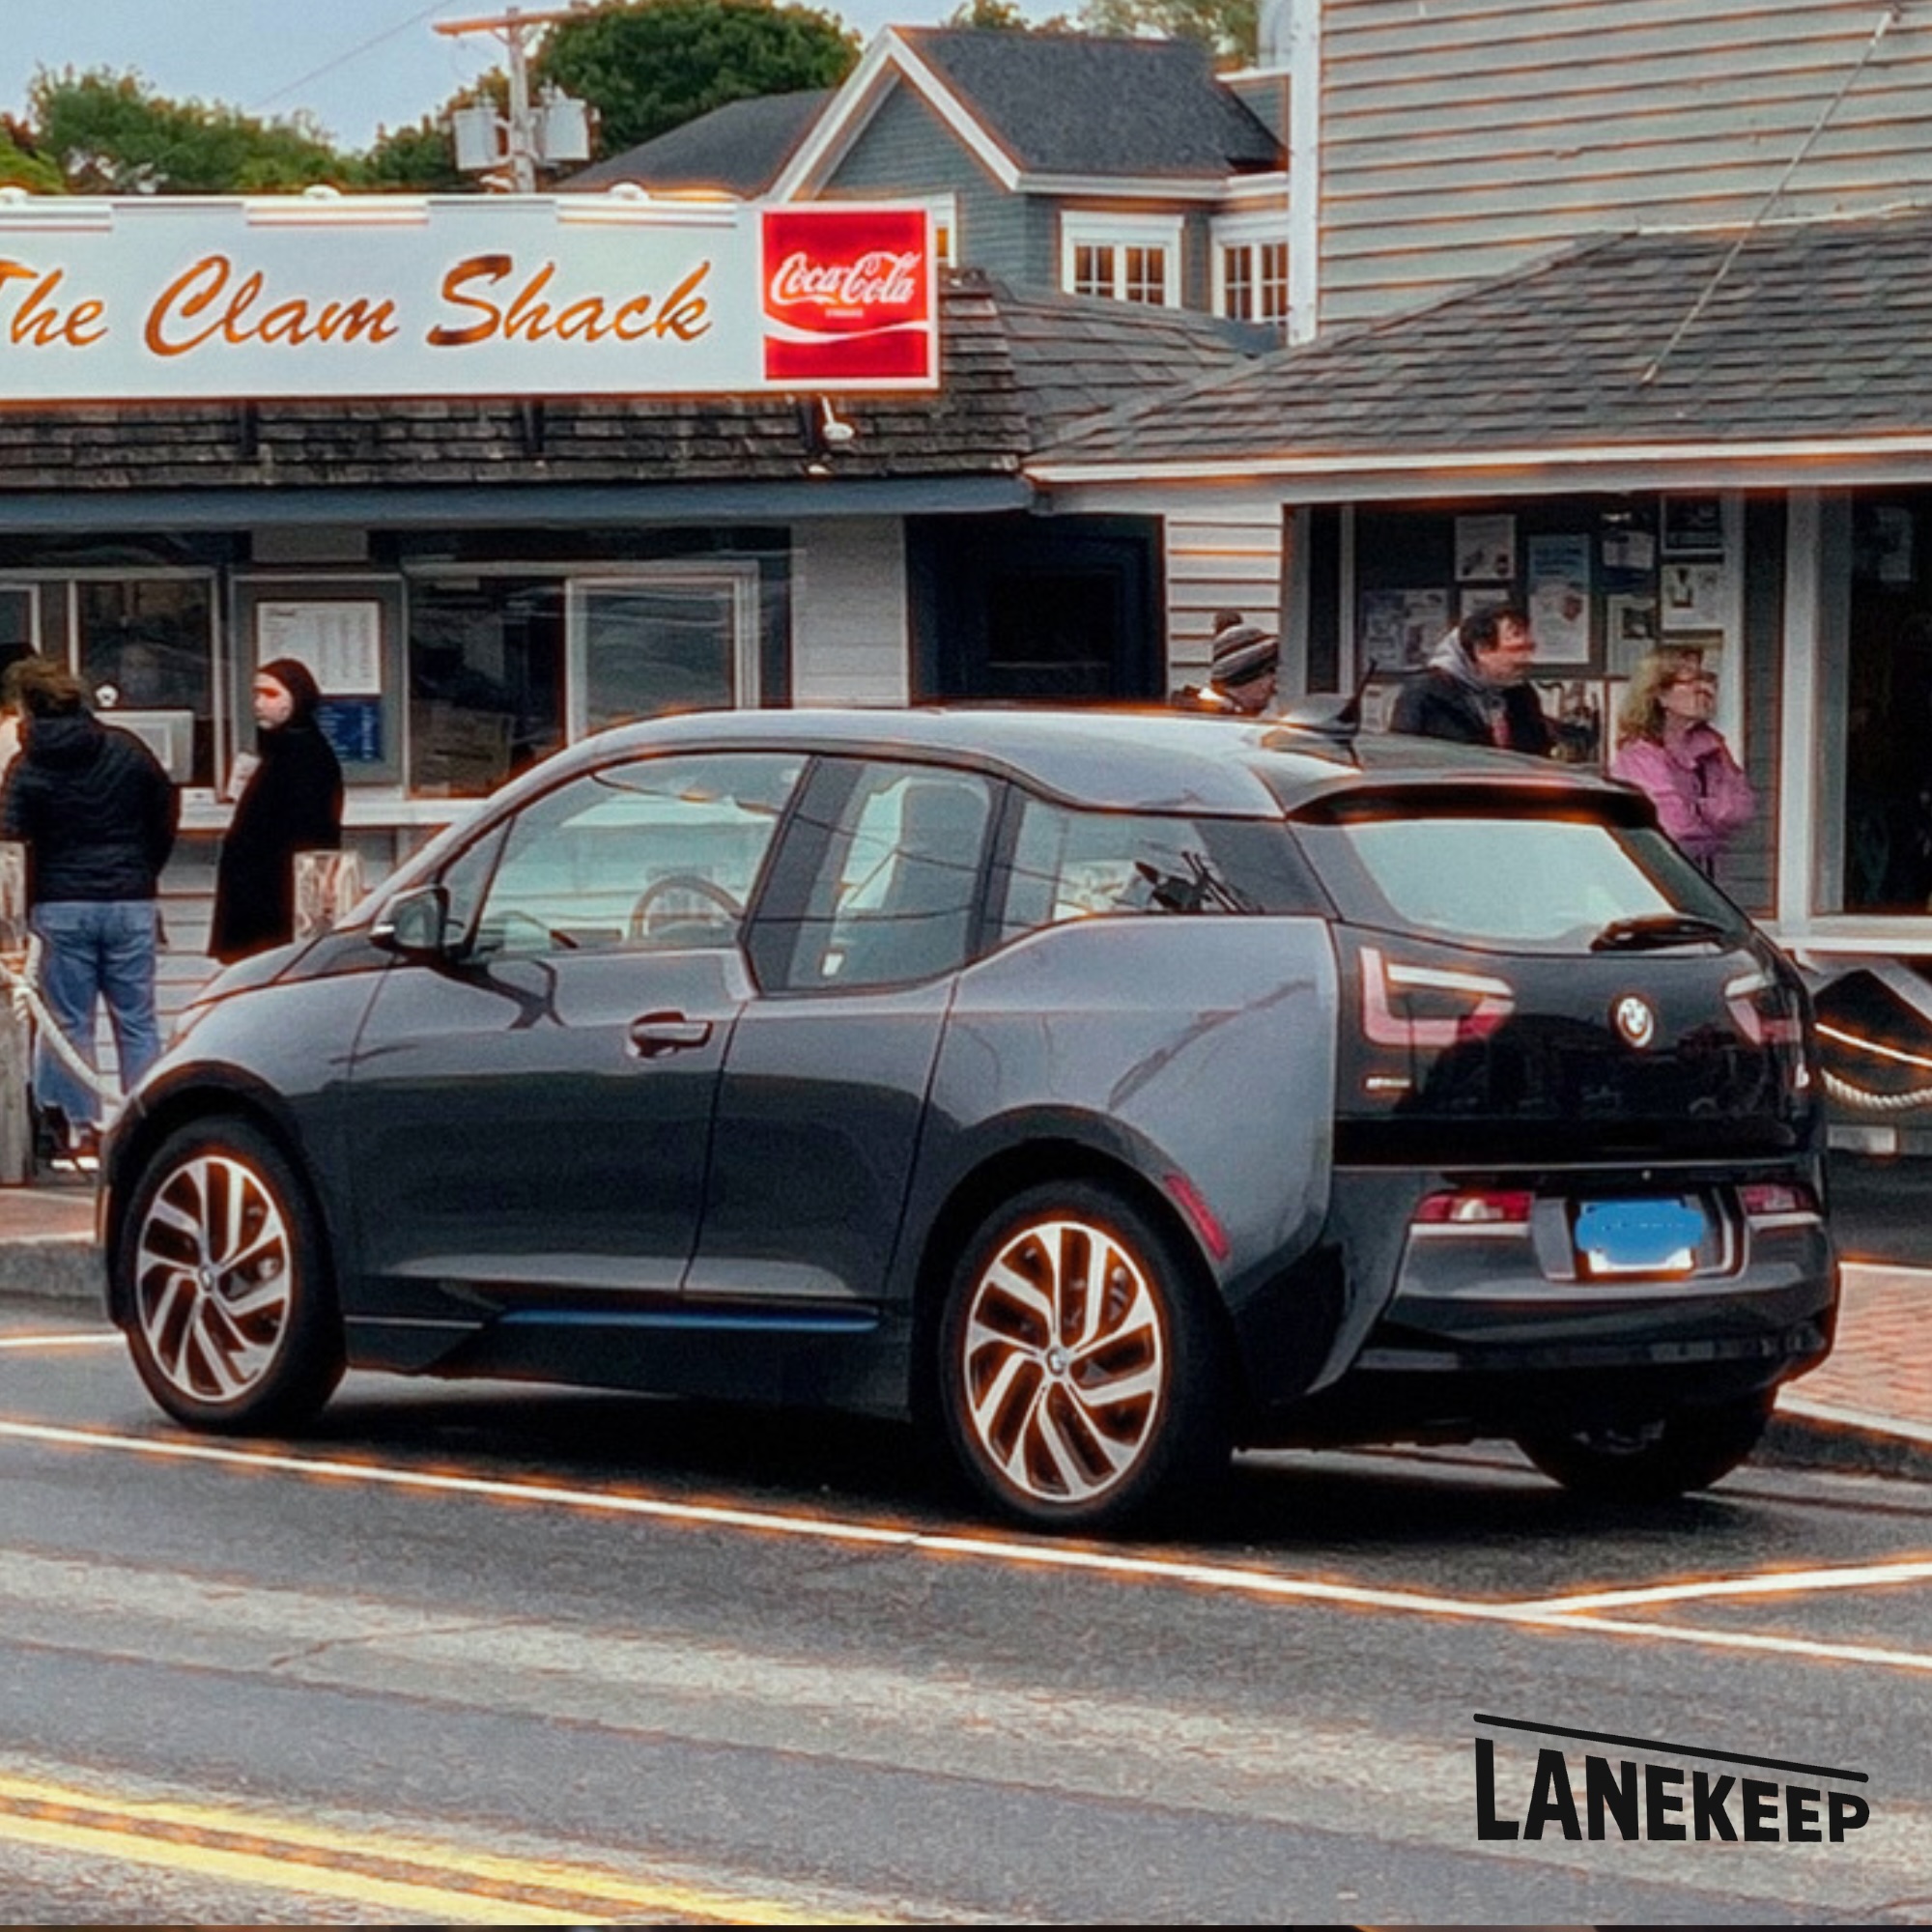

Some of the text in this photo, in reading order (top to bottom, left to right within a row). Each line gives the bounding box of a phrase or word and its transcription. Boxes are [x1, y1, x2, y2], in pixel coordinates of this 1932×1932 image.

[145, 254, 398, 356] Clam
[426, 255, 711, 347] Shack
[770, 251, 923, 306] Coca-Cola
